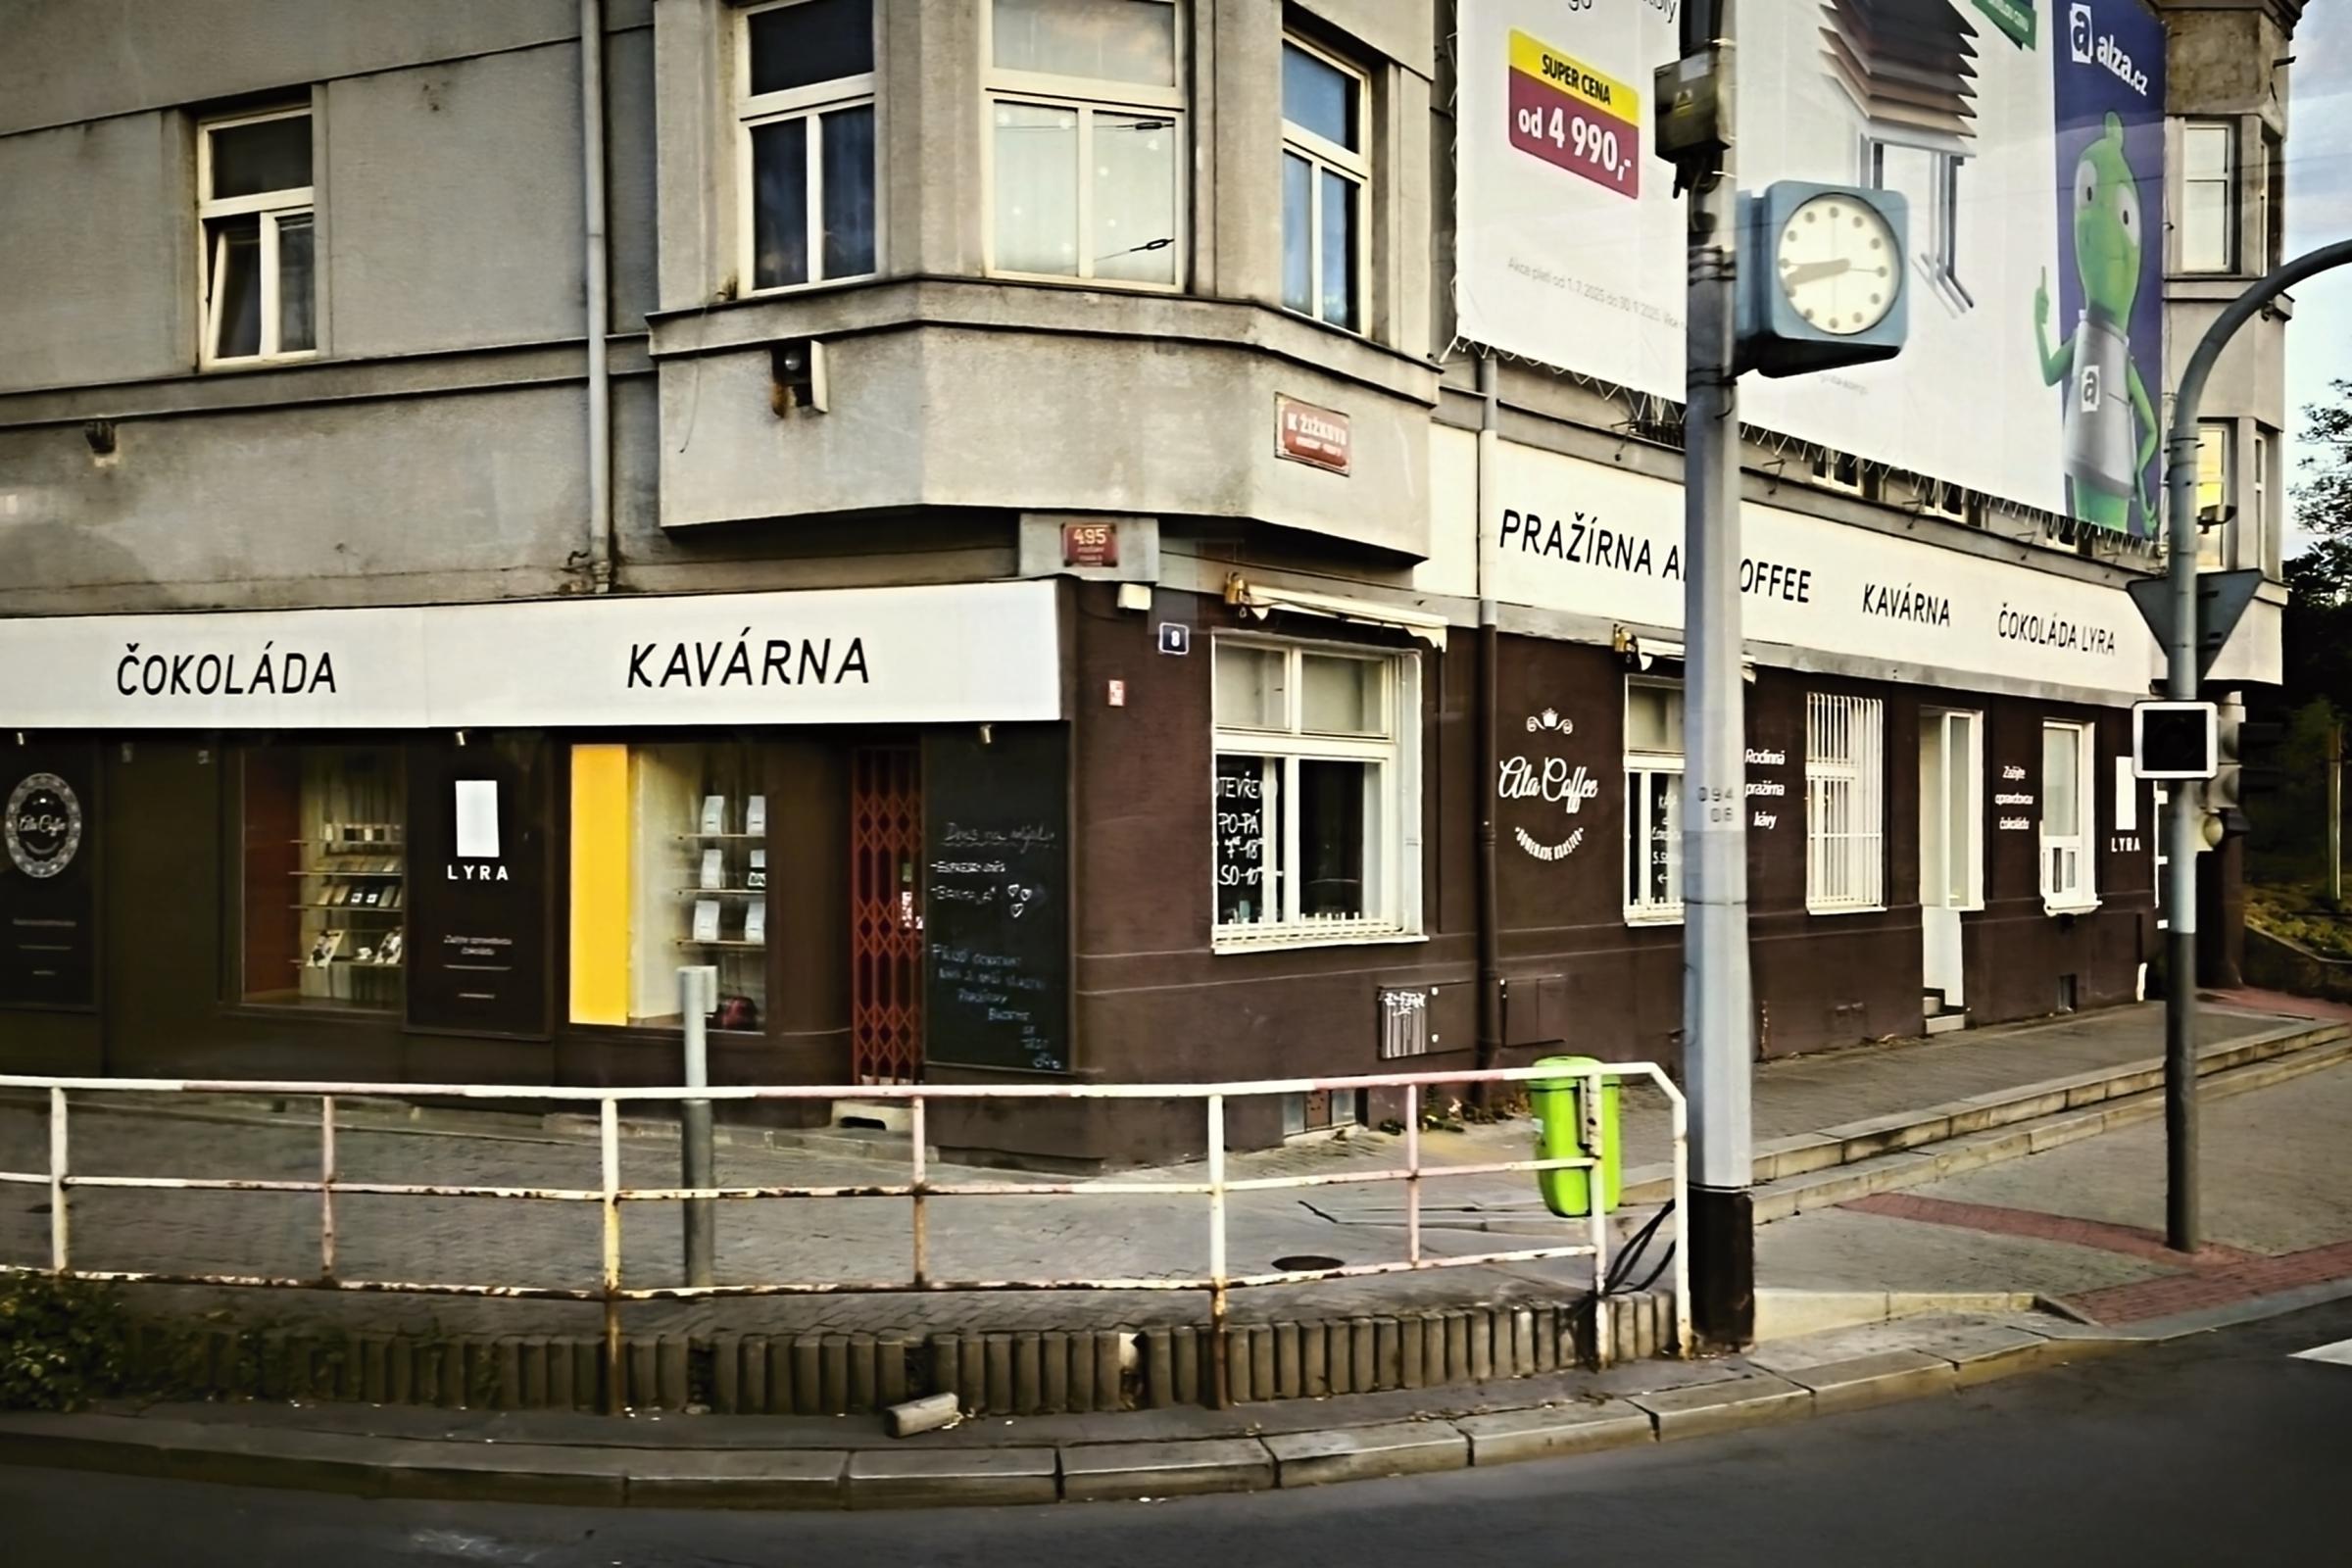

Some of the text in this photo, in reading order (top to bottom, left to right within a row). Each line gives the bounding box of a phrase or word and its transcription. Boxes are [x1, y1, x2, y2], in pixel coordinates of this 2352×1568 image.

[1543, 54, 1611, 105] SUPER CENA
[2096, 34, 2148, 96] alza.cz
[1518, 106, 1543, 139] od
[1073, 527, 1106, 545] 495
[1499, 509, 1651, 576] PRAŽÍRNA
[1740, 559, 1812, 603] OFFEE
[1862, 582, 1950, 627] KAVÁRNA
[1997, 602, 2115, 656] ČOKOLÁDA LYRA
[117, 640, 337, 696] ČOKOLÁDA
[626, 625, 870, 688] KAVÁRNA
[1498, 756, 1598, 813] Ala Coffee
[2111, 837, 2140, 853] LYRA
[447, 864, 509, 880] LYRA
